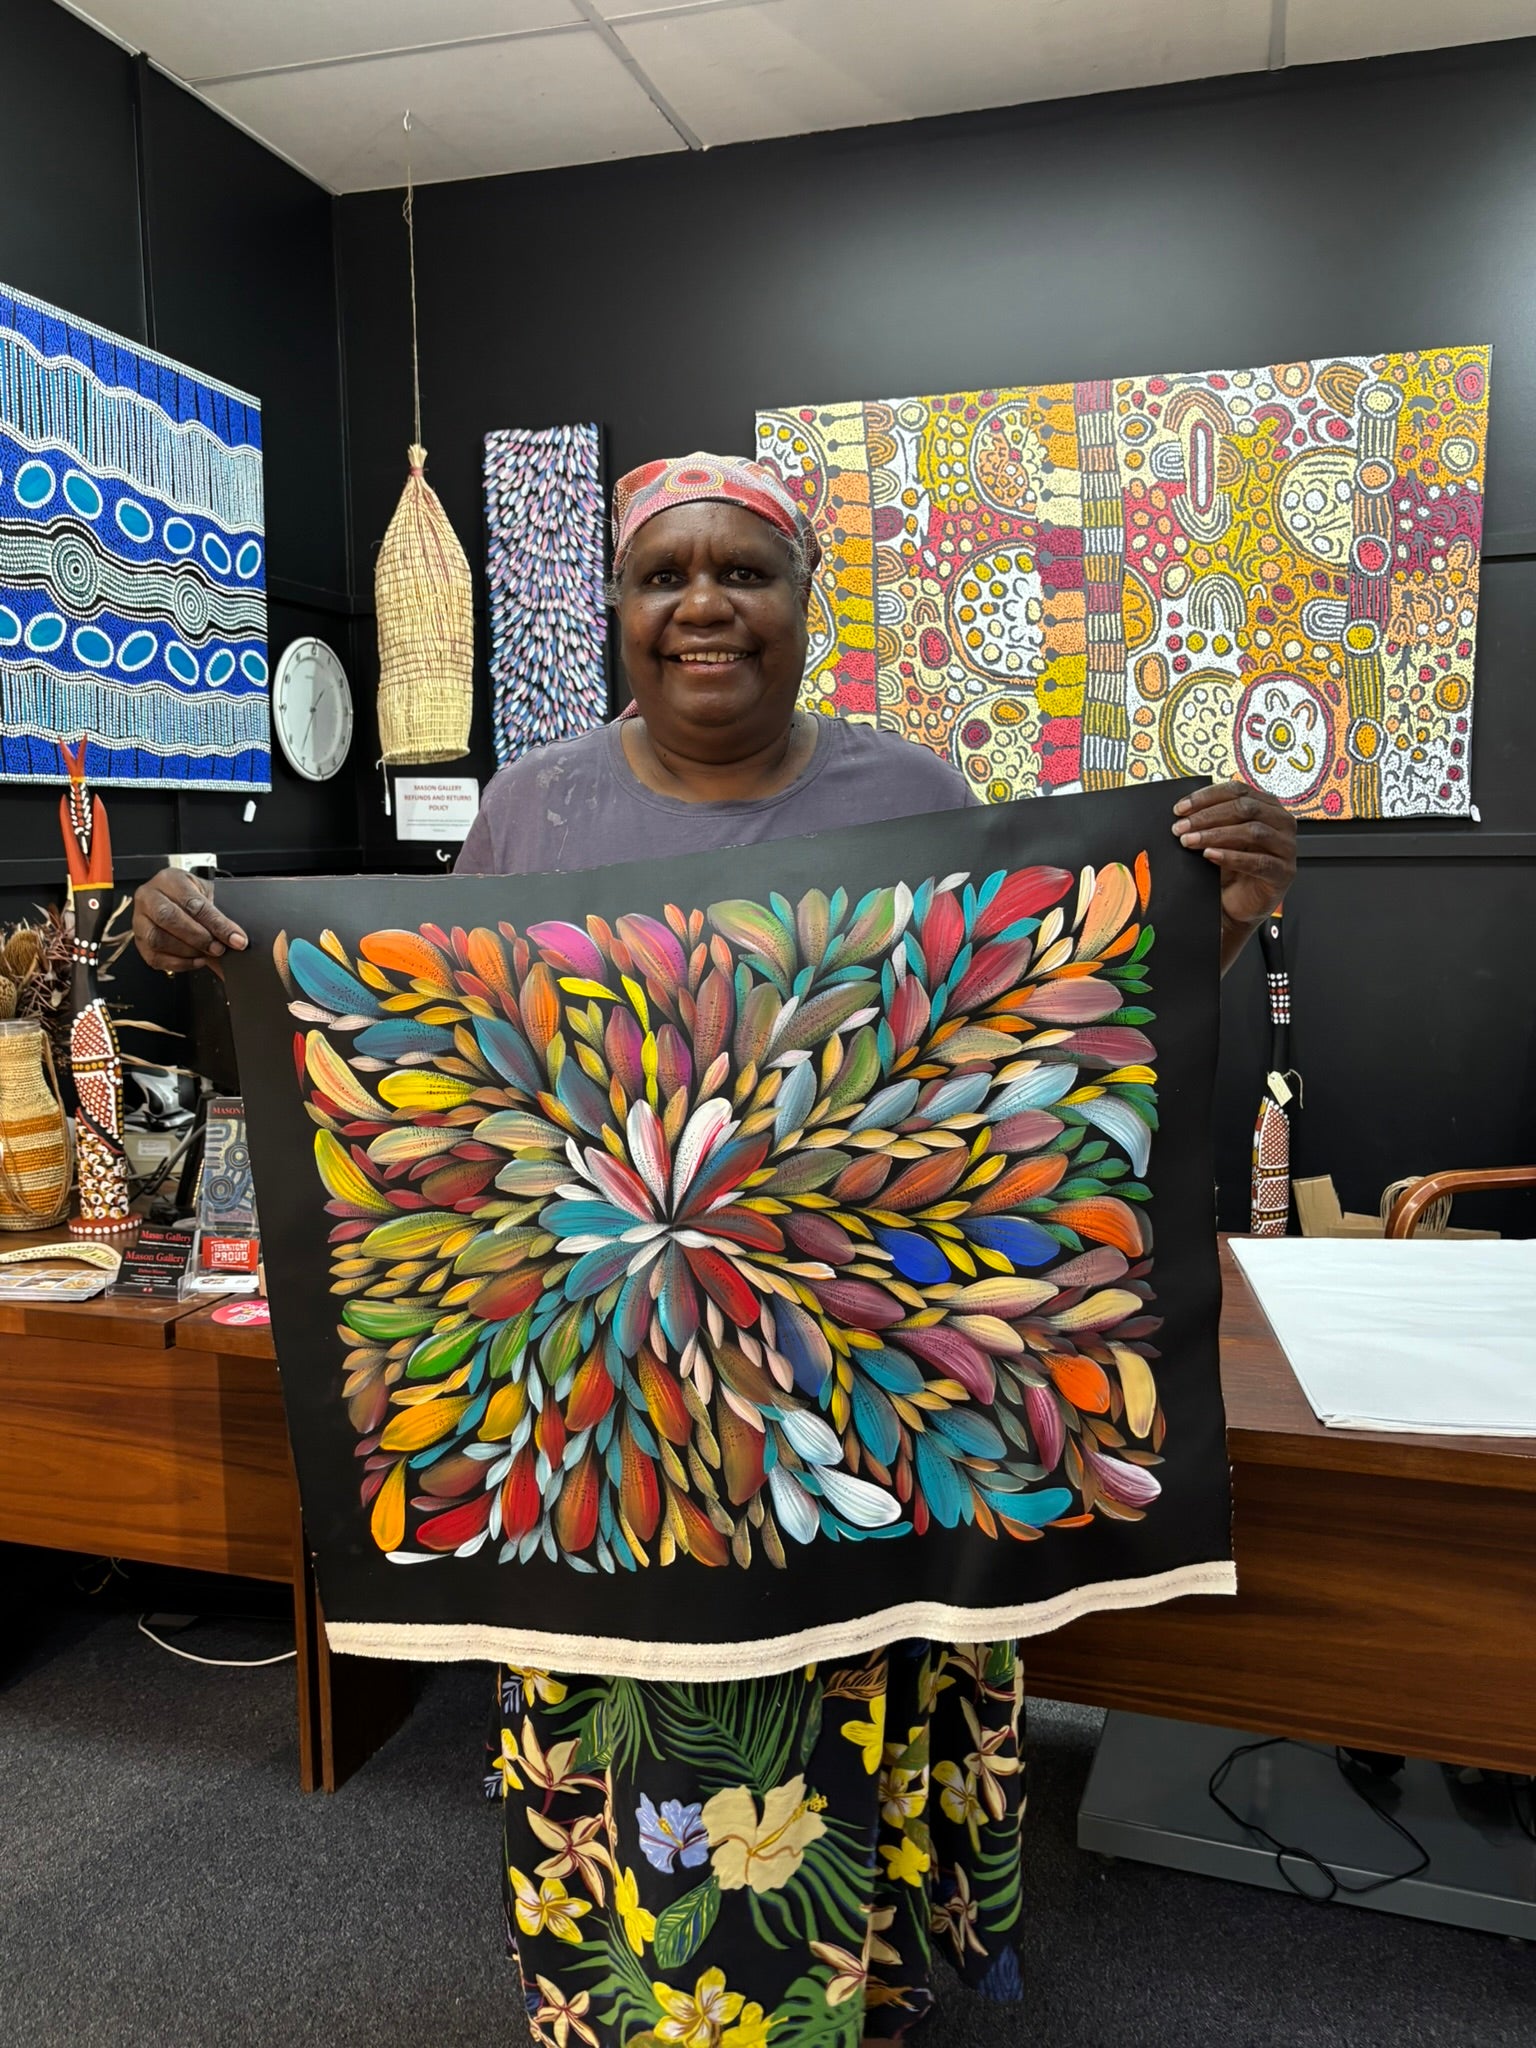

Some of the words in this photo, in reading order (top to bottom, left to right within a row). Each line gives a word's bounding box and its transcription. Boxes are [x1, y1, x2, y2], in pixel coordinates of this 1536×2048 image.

[213, 1107, 241, 1115] MASON
[141, 1230, 164, 1240] Mason
[165, 1232, 191, 1243] Gallery
[125, 1250, 154, 1261] Mason
[156, 1252, 186, 1264] Gallery
[214, 1251, 248, 1262] PROUD
